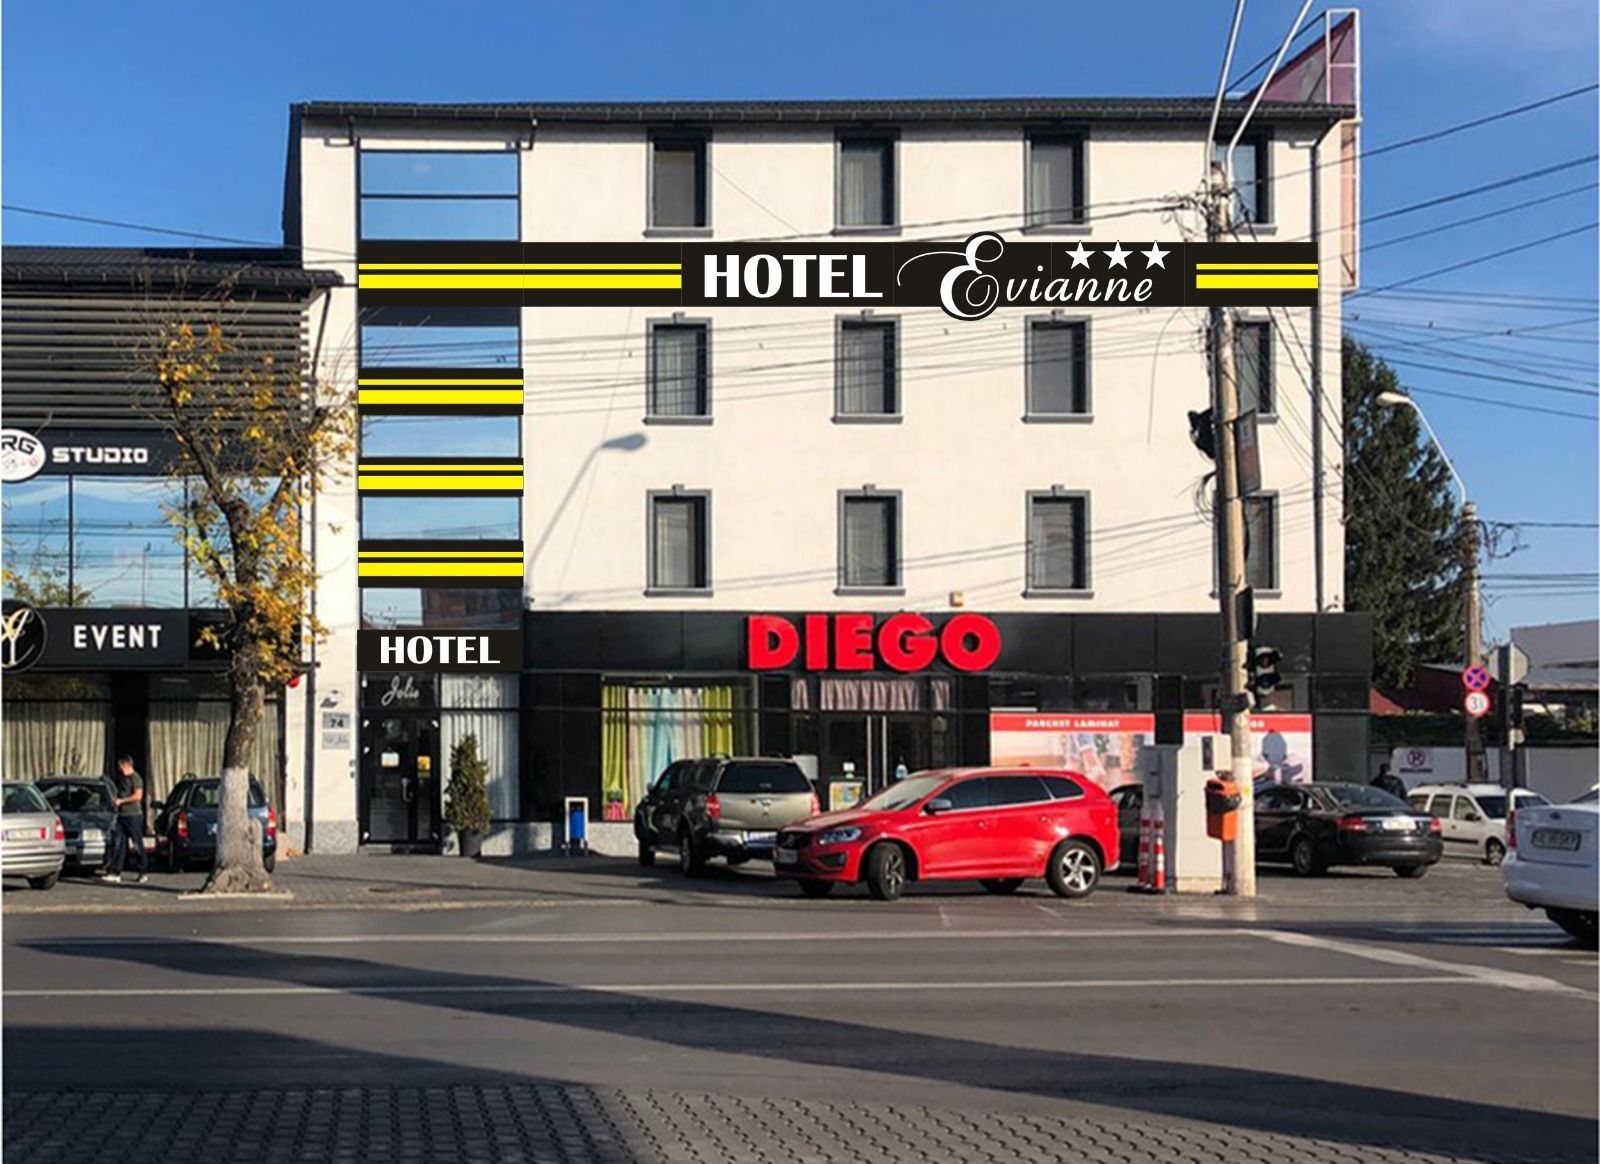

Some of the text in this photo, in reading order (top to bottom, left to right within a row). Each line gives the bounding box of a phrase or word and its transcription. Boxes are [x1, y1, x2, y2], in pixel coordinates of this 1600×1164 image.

[704, 233, 1154, 318] HOTEL Evianne
[51, 446, 150, 464] STUDIO
[73, 624, 163, 651] EVENT
[379, 635, 501, 665] HOTEL
[748, 611, 1002, 672] DIEGO
[1073, 719, 1120, 728] LAMINAT
